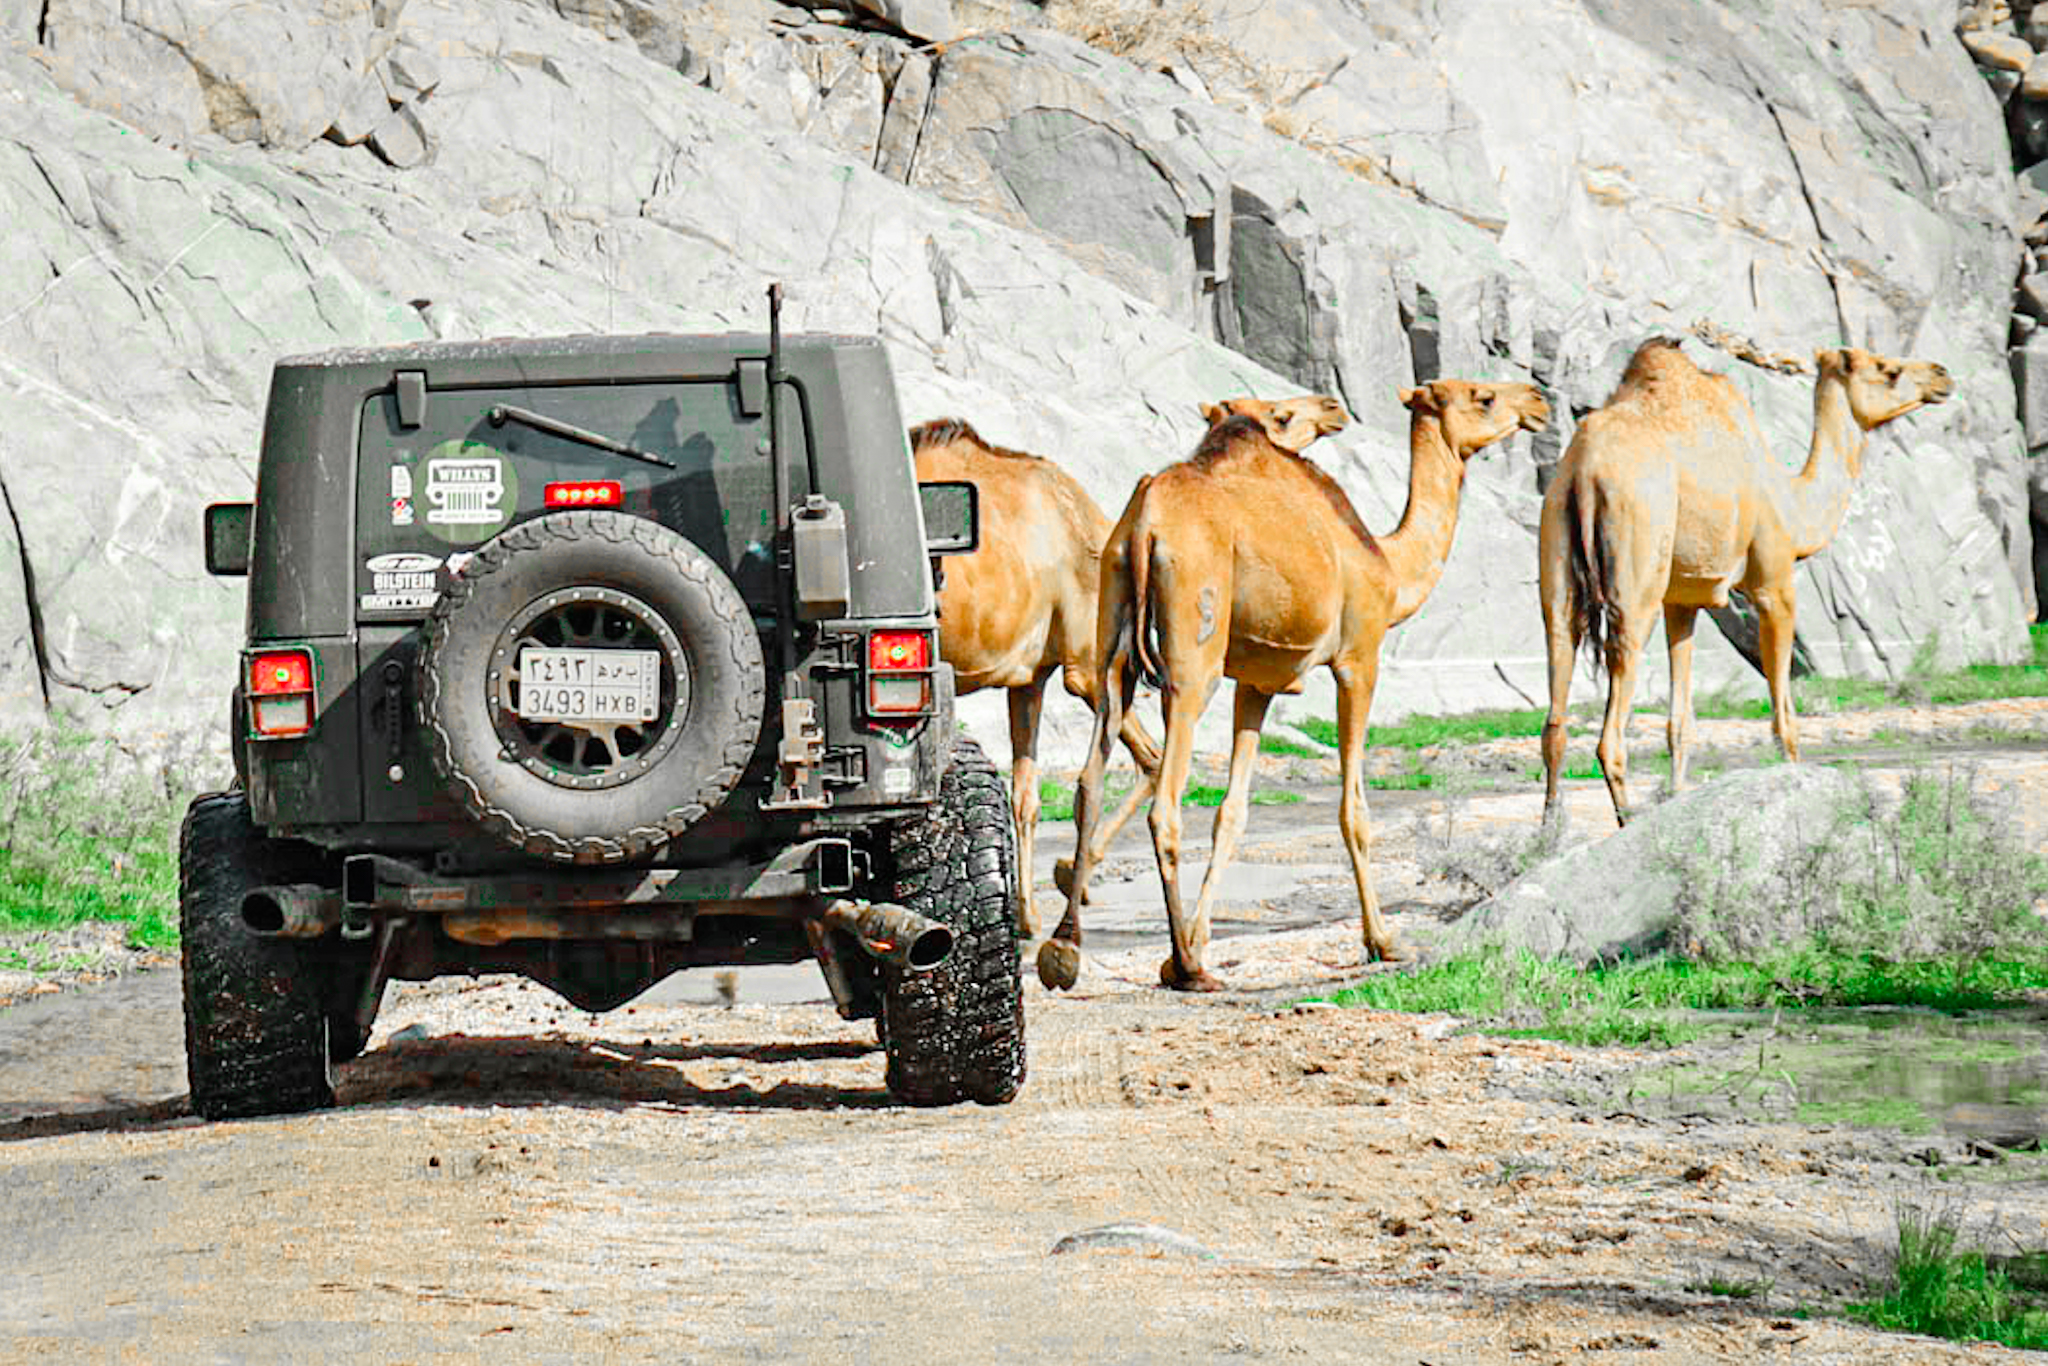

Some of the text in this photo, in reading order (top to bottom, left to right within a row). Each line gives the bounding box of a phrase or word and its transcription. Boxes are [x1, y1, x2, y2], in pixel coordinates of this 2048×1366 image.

[438, 469, 490, 481] WILLYS
[374, 573, 435, 589] BILSTEIN
[527, 689, 586, 715] 3493
